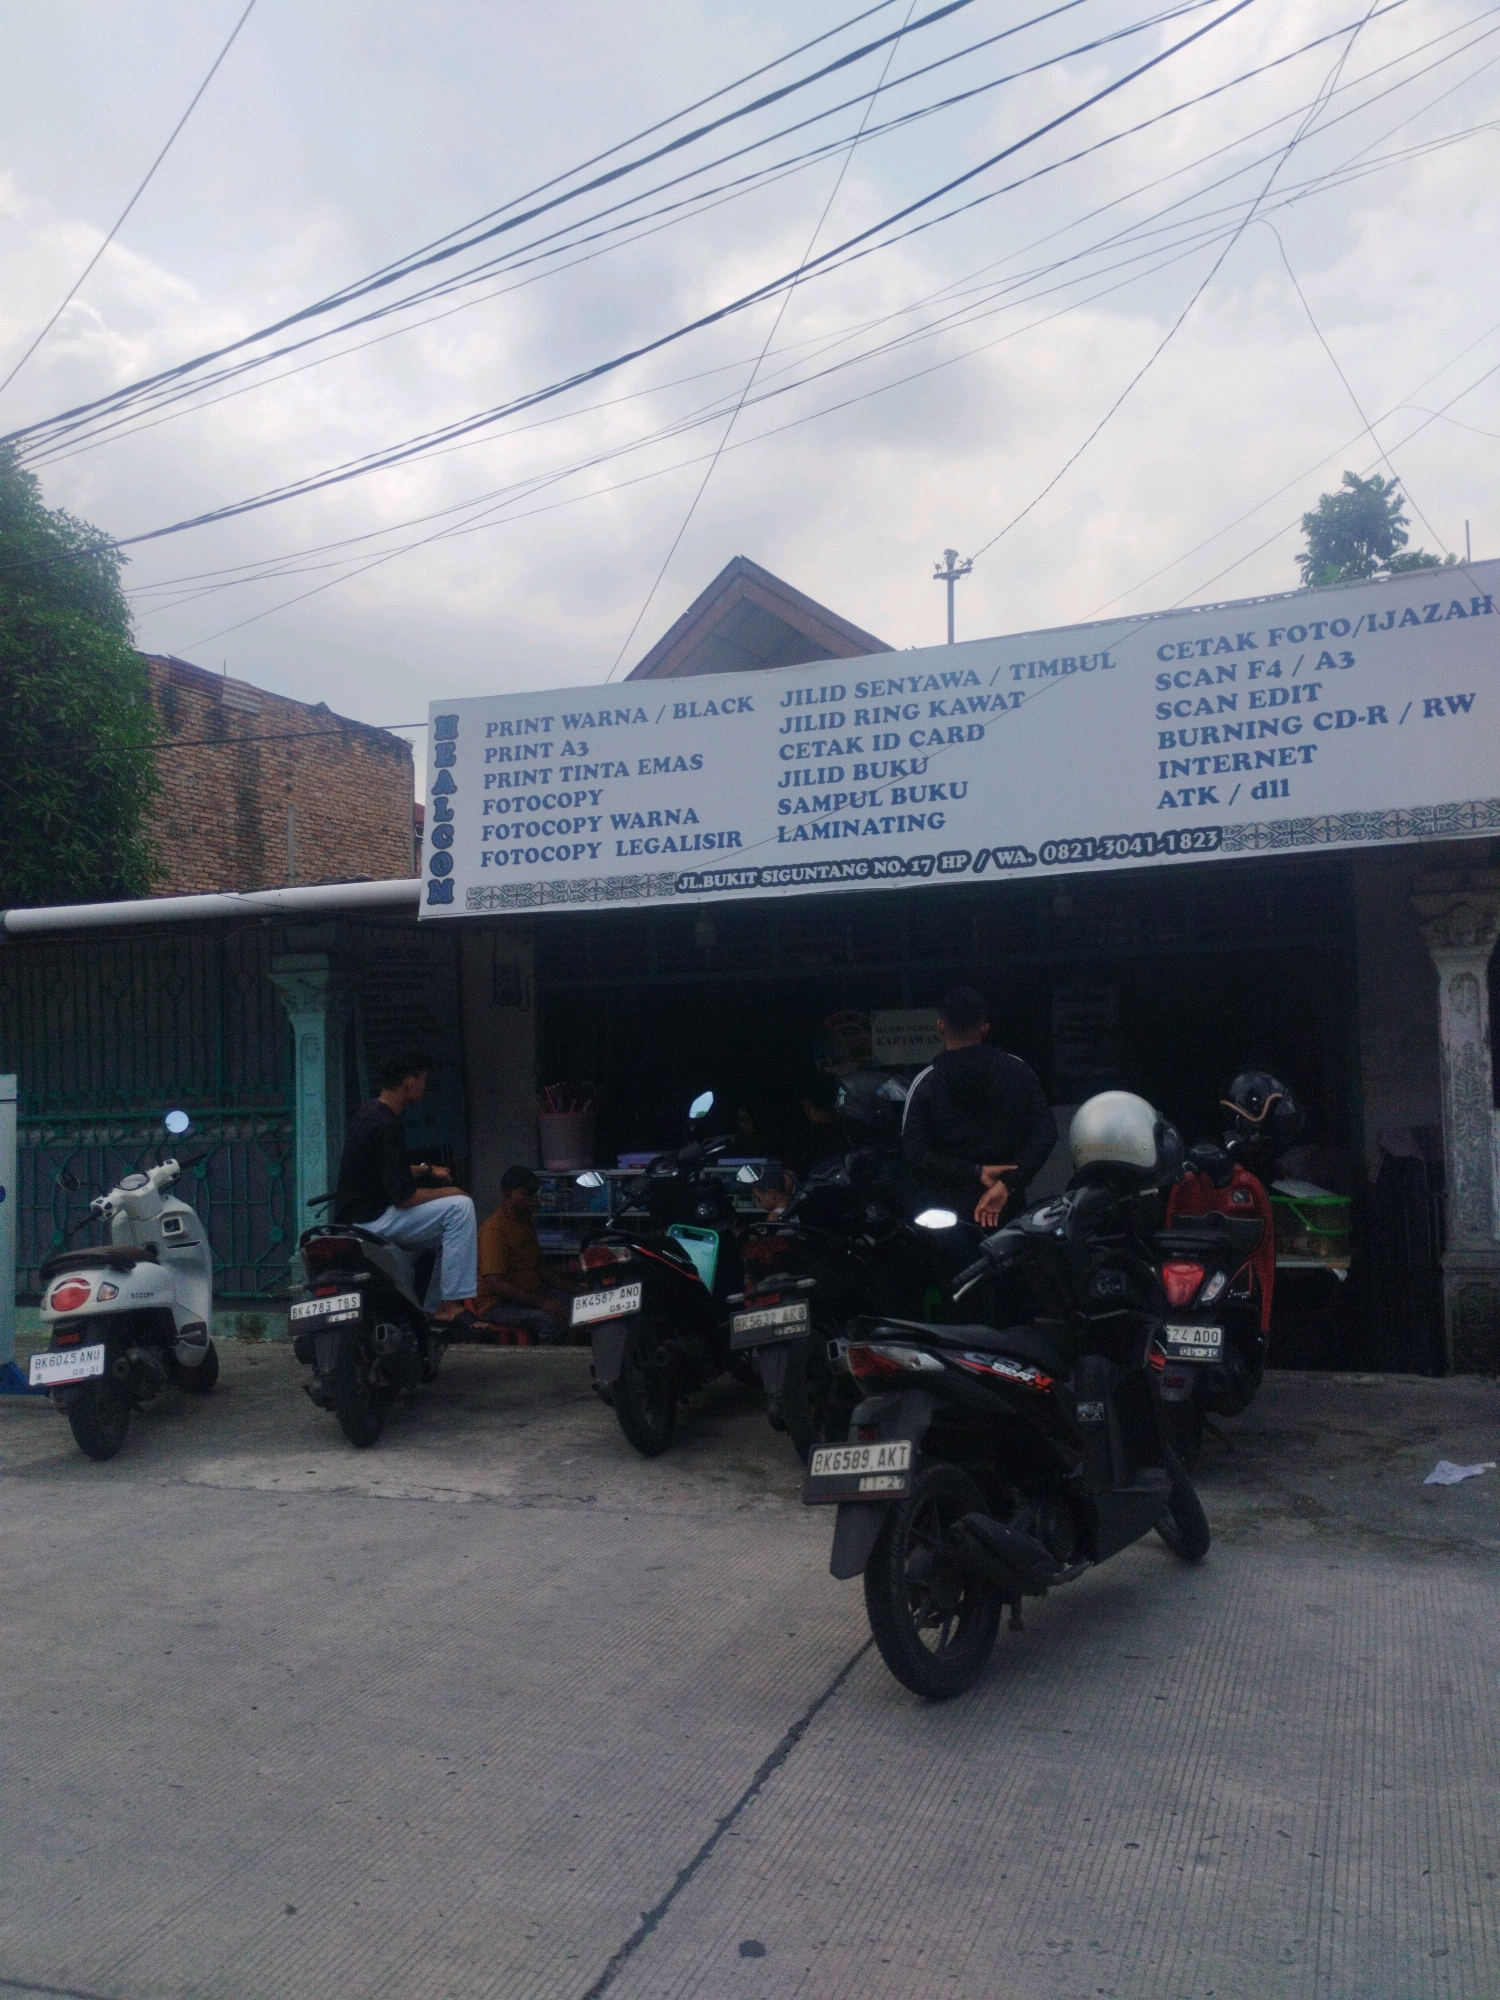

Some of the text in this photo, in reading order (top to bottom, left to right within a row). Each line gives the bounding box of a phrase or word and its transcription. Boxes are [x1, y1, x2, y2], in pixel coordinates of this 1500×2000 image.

[1156, 632, 1258, 662] CETAK
[780, 684, 847, 708] JILID
[854, 670, 980, 698] SENYAWA
[1009, 652, 1116, 681] TIMBUL
[1156, 664, 1237, 691] SCAN
[1248, 659, 1283, 679] F4
[1315, 651, 1356, 670] A3
[485, 716, 555, 738] PRINT
[562, 707, 648, 731] WARNA
[673, 696, 754, 719] BLACK
[779, 691, 1026, 734] JILID RING KAWAT
[1156, 683, 1322, 720] SCAN EDIT
[1158, 716, 1302, 750] BURNING
[1313, 705, 1388, 731] CD-R
[1423, 694, 1476, 718] RW
[485, 741, 589, 763] PRINT A3
[779, 723, 985, 761] CETAK ID CARD
[484, 754, 704, 789] PRINT TINTA EMAS
[778, 757, 929, 788] JILID BUKU
[1159, 744, 1317, 780] INTERNET
[427, 714, 459, 905] HEALCOM
[482, 789, 604, 816] FOTOCOPY
[778, 781, 969, 816] SAMPUL BUKU
[1157, 785, 1220, 809] ATK
[1251, 779, 1290, 800] dll
[482, 808, 699, 842] FOTOCOPY WARNA
[778, 812, 946, 843] LAMINATING
[481, 831, 743, 868] FOTOCOPY LEGALISIR
[678, 871, 758, 889] JL.BUKIT
[761, 862, 868, 884] SIGUNTANG
[873, 860, 905, 875] NO.
[911, 859, 931, 872] 17
[942, 854, 967, 869] HP
[996, 850, 1034, 865] WA.
[1044, 831, 1218, 860] 0821-3041-1823
[877, 1035, 941, 1046] KARYAWAN
[293, 1297, 357, 1318] BK4783 TBS
[35, 1350, 100, 1369] BK6045 ANU
[814, 1446, 907, 1472] BK6589 AKT
